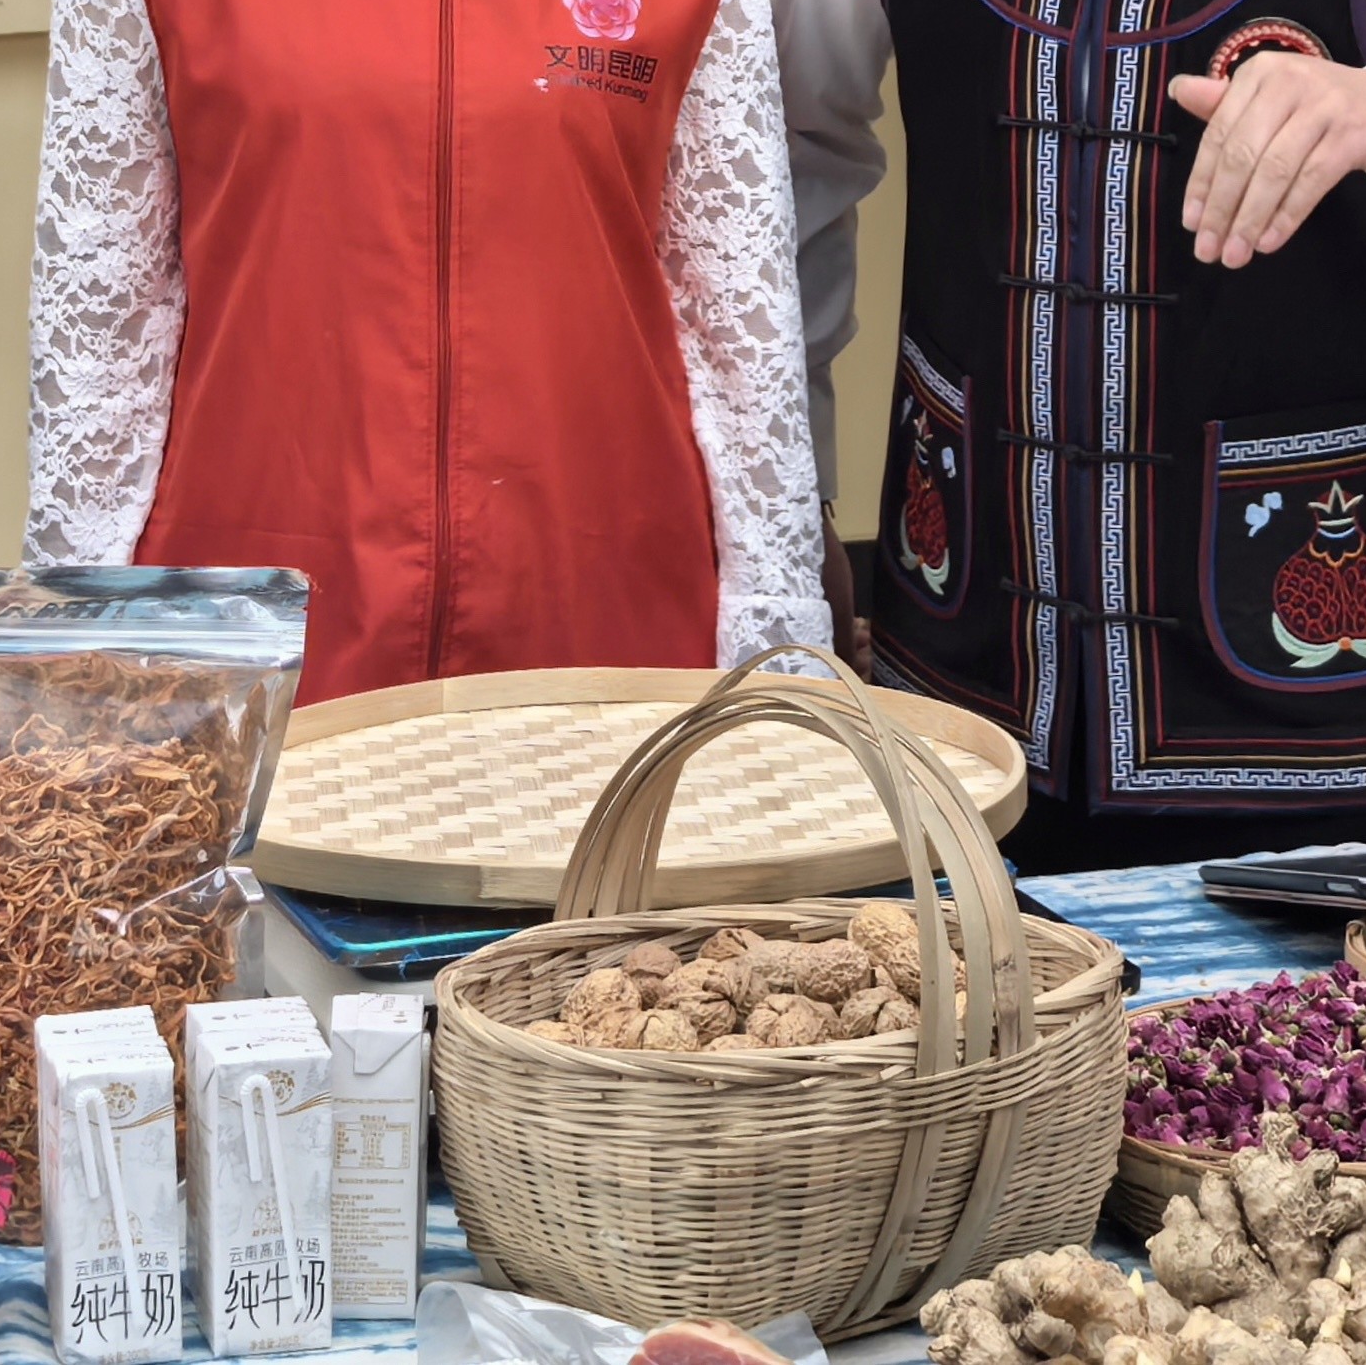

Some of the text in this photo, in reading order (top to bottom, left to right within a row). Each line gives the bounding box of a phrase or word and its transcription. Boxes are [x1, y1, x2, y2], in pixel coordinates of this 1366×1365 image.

[544, 45, 659, 84] 文明昆明
[75, 1251, 170, 1277] 云南高牧场
[70, 1273, 176, 1344] 纯牛奶
[224, 1259, 325, 1330] 纯牛奶
